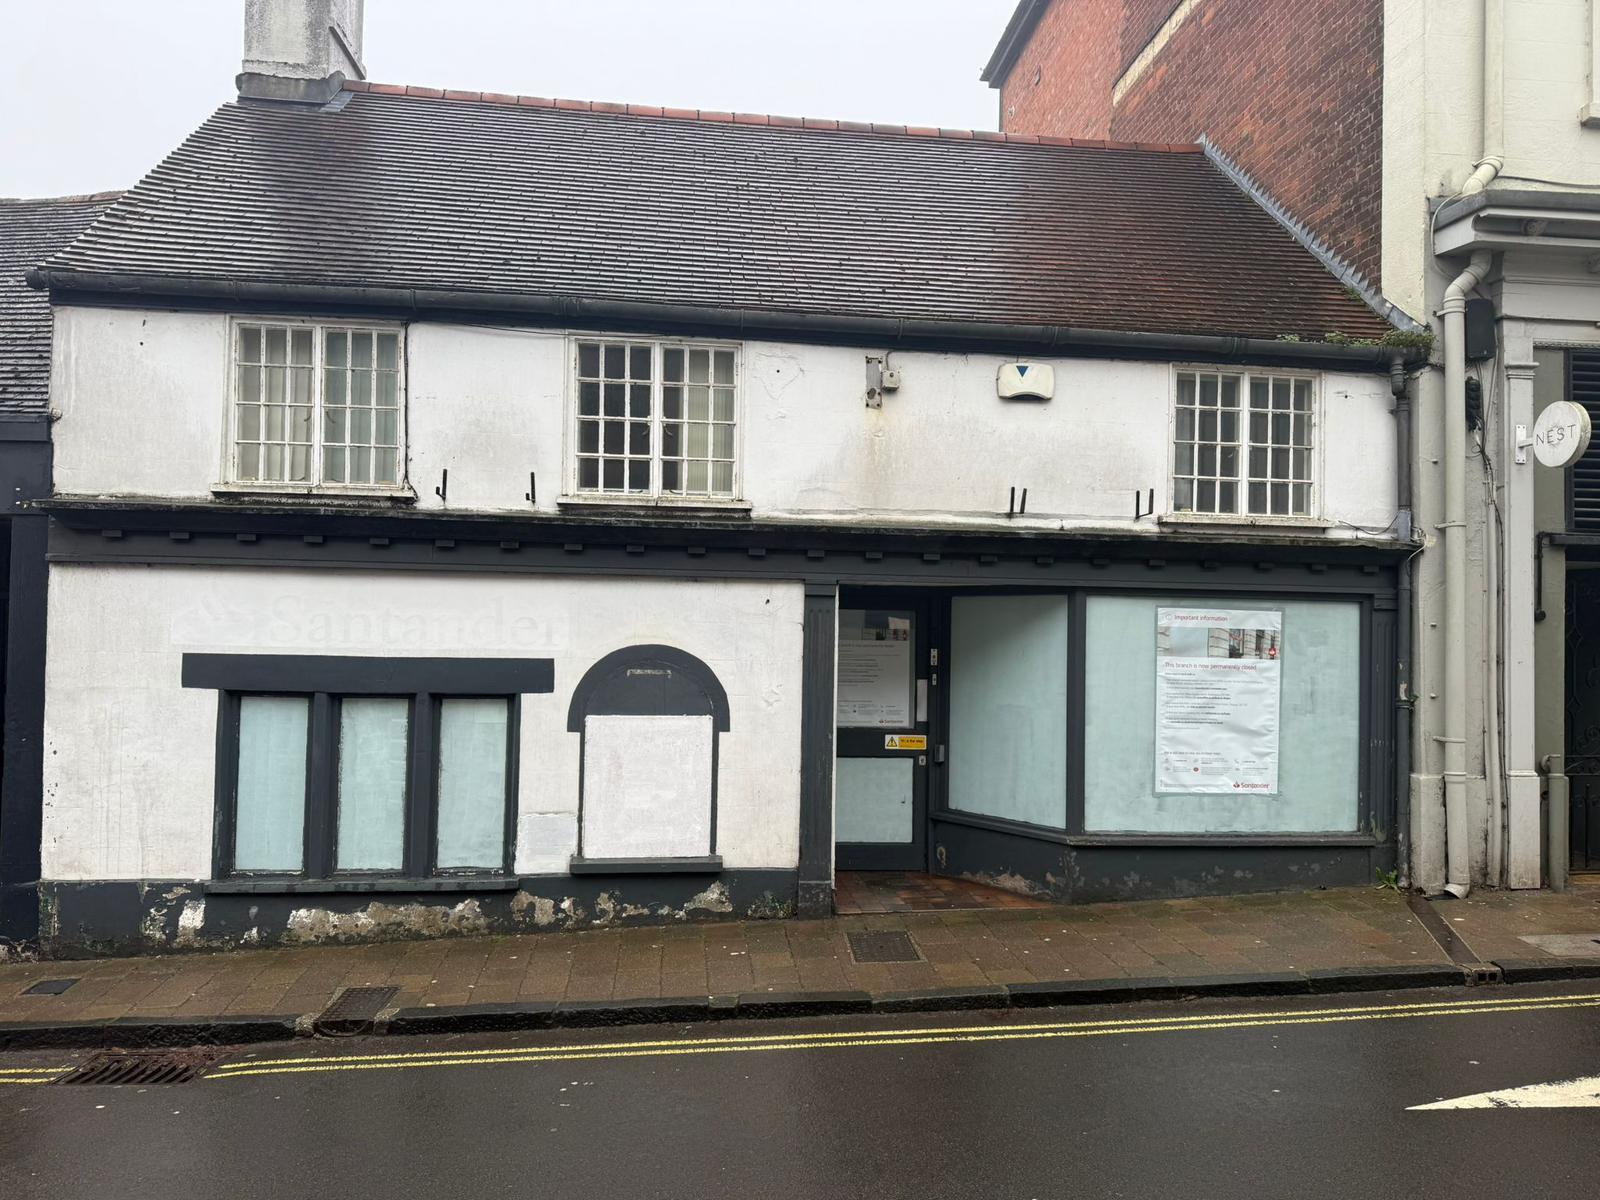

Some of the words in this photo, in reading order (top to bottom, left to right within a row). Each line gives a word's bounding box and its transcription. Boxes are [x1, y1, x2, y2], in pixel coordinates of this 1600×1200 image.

[1536, 424, 1576, 446] NEST
[268, 594, 561, 646] Santander
[1174, 614, 1199, 622] Important
